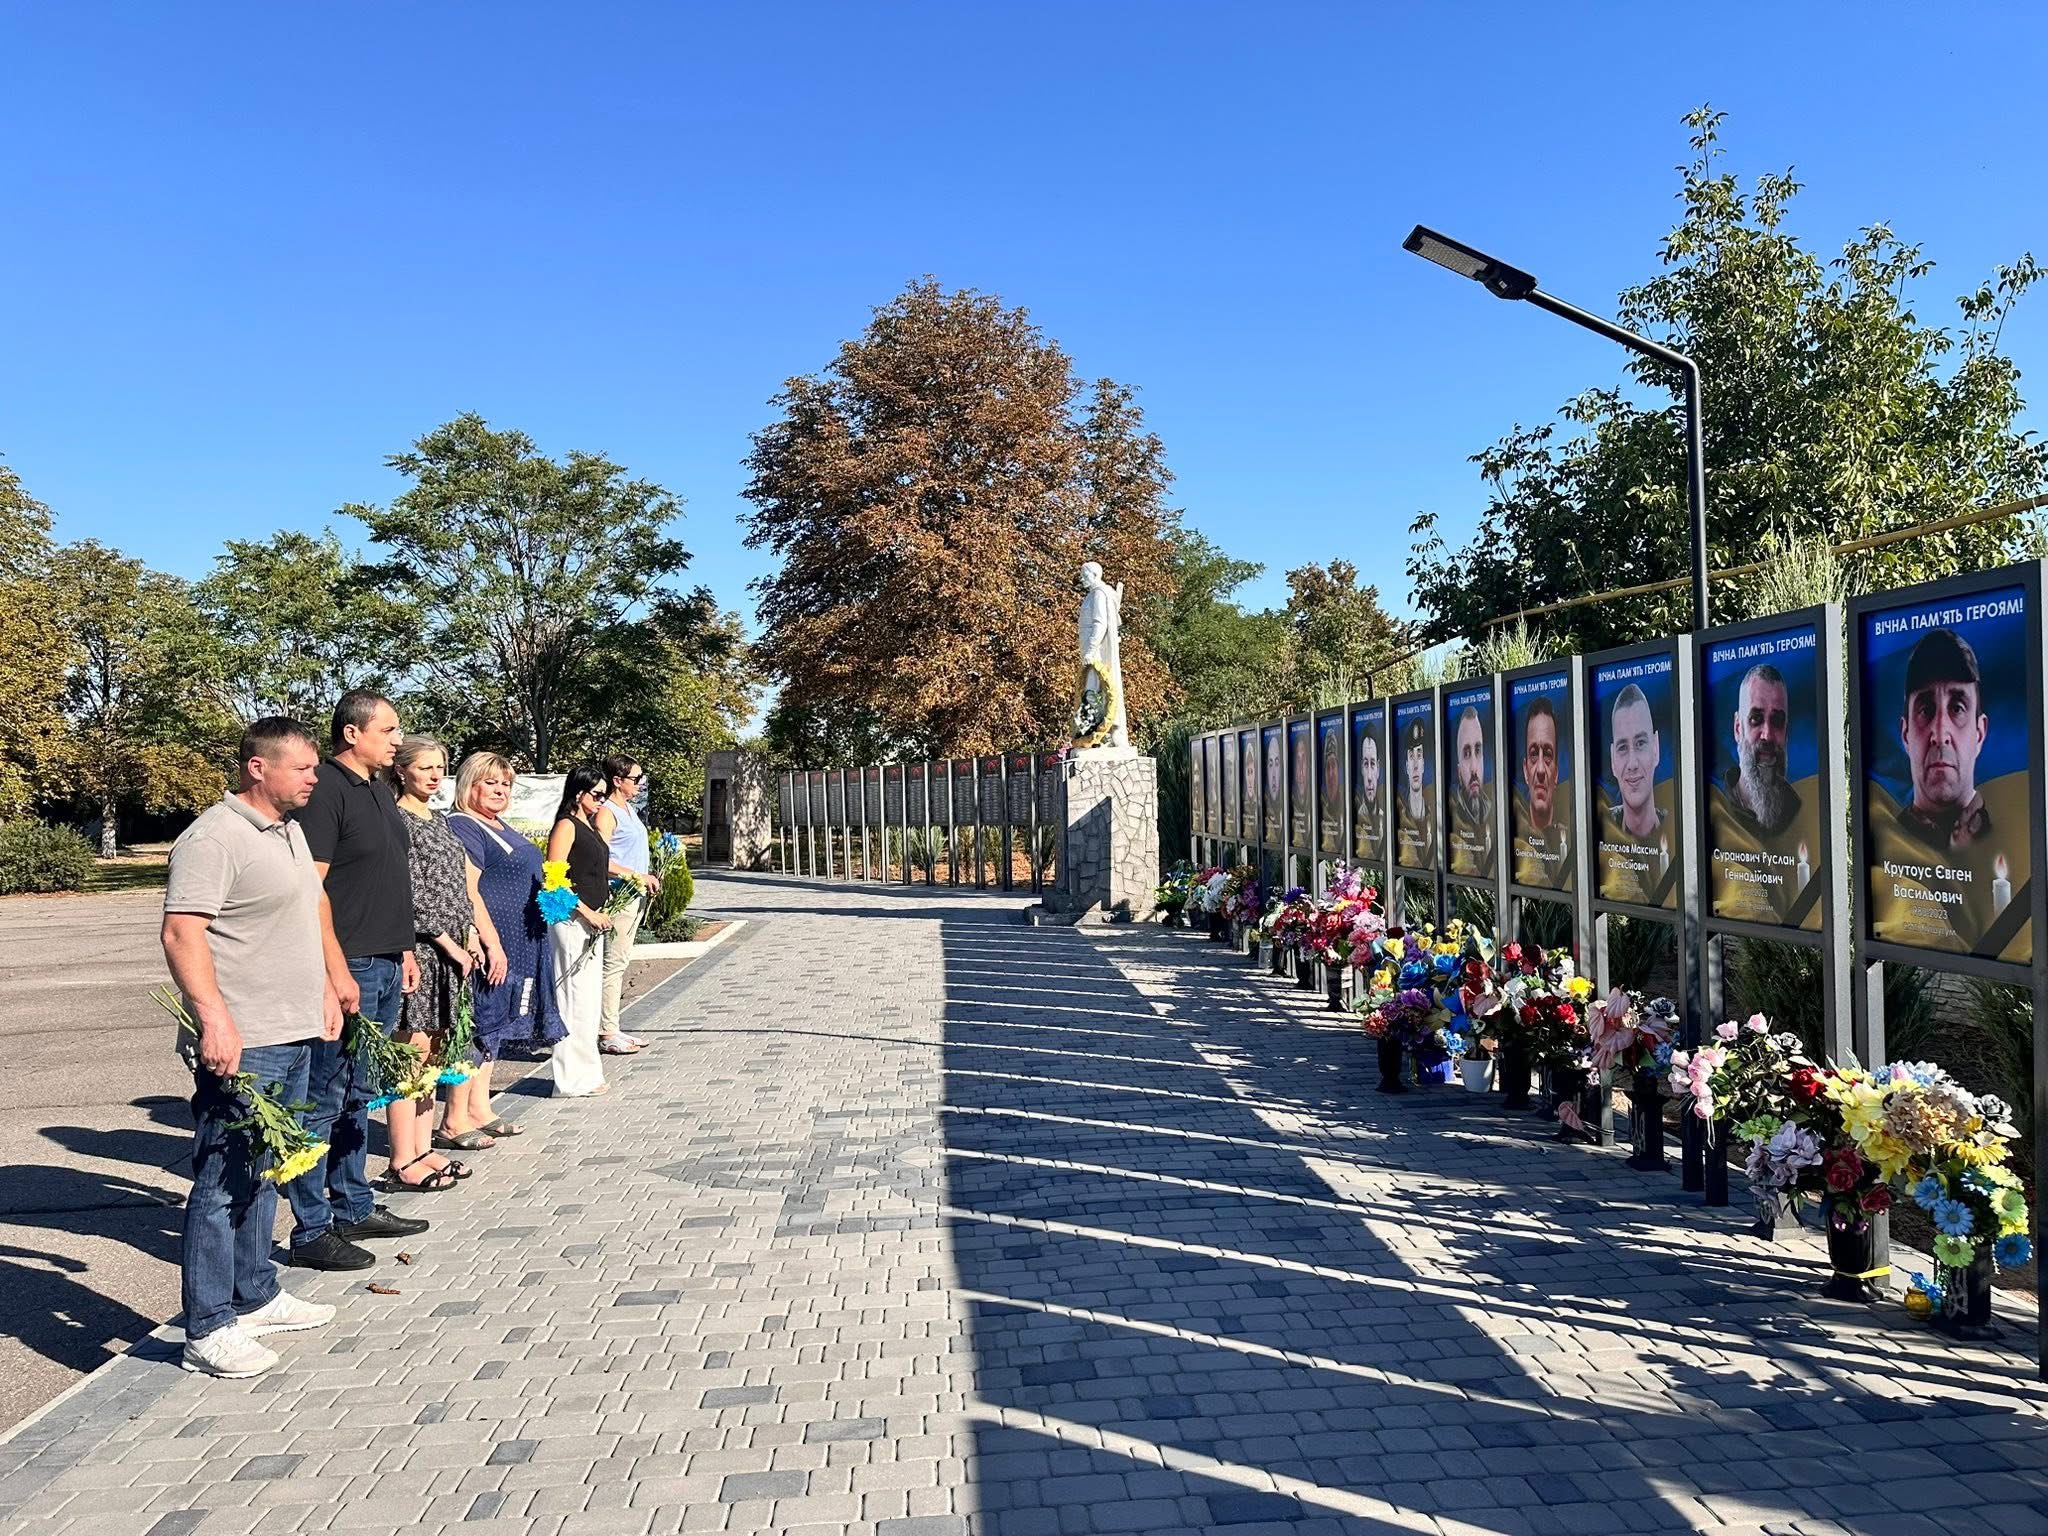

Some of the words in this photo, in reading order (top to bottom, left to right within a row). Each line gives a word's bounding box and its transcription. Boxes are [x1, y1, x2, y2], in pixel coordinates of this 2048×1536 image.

[1875, 618, 1908, 635] ВІЧНА
[1911, 609, 1963, 630] ПАМ'ЯТЬ
[1966, 598, 2023, 621] ГЕРОЯМ!
[1713, 648, 1736, 663] ВІЧНА
[1738, 642, 1774, 659] ПАМ'ЯТЬ
[1776, 634, 1816, 652] ГЕРОЯМ!
[1631, 843, 1659, 855] Максим
[1713, 848, 1760, 863] Суранович
[1762, 851, 1795, 866] Руслан
[1608, 857, 1649, 871] Олексійович
[1883, 860, 1932, 880] Крутоус
[1935, 865, 1973, 882] Євген
[1724, 868, 1783, 884] Геннадійович
[1893, 884, 1963, 905] Васильович
